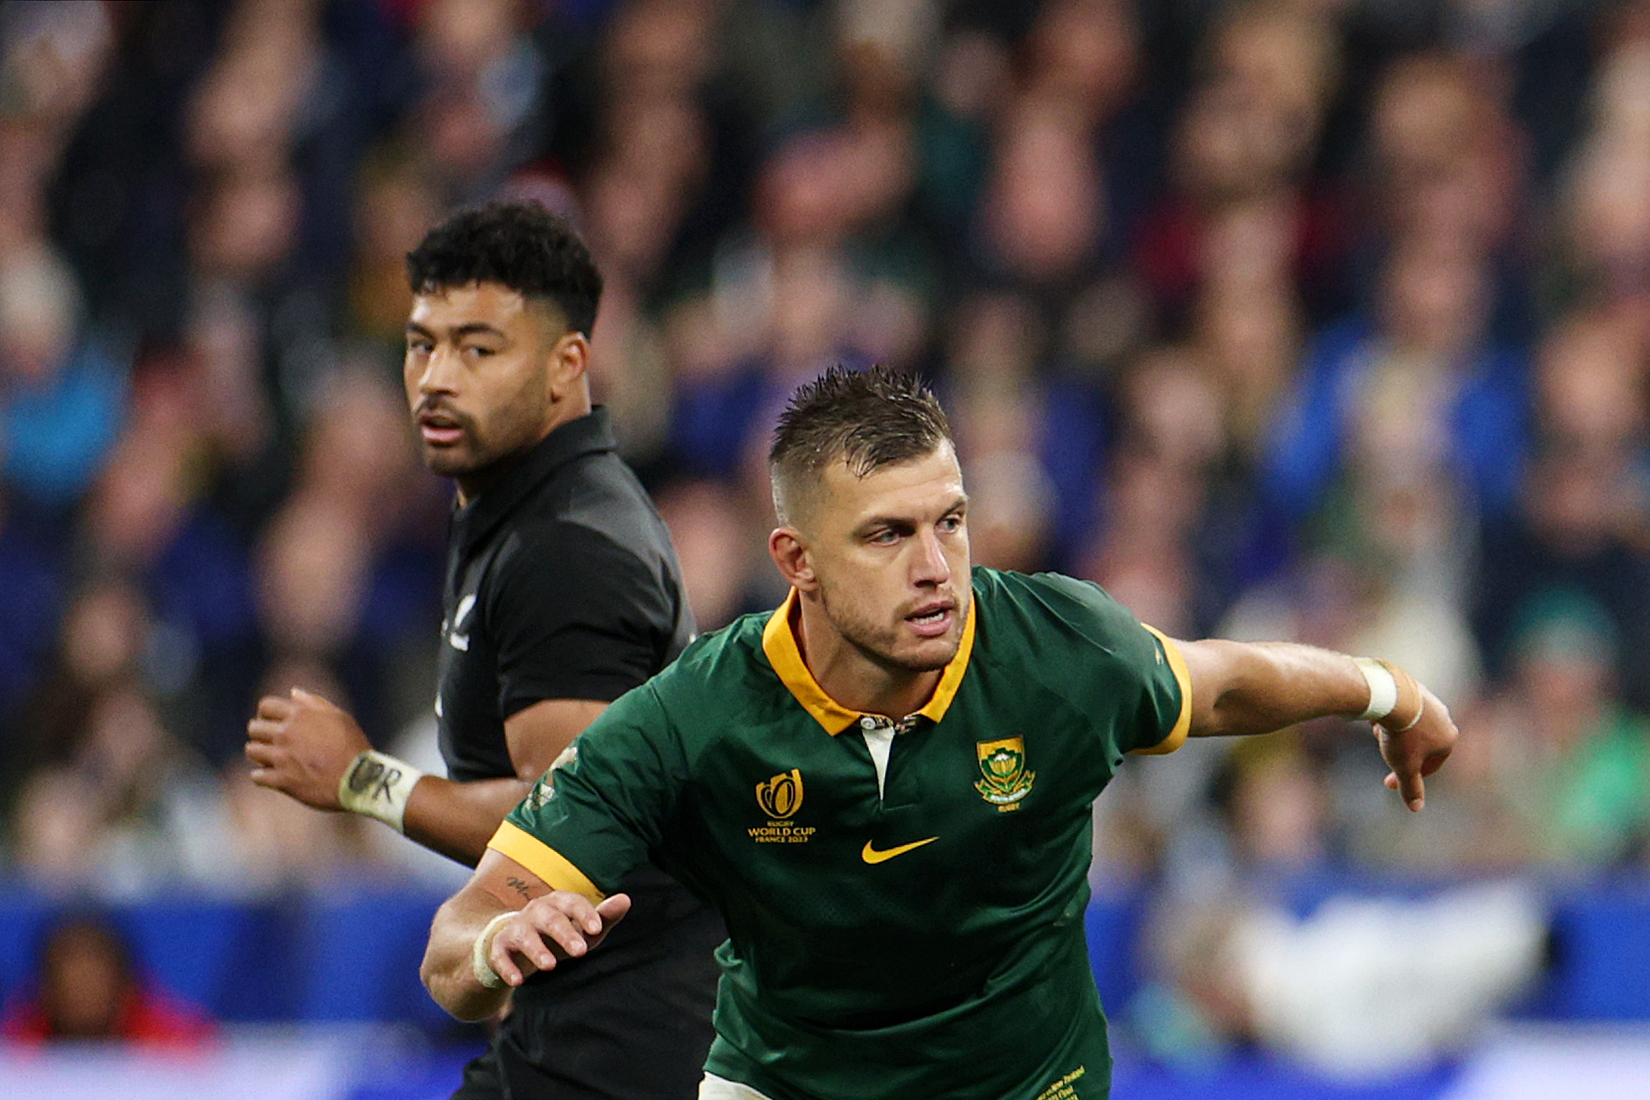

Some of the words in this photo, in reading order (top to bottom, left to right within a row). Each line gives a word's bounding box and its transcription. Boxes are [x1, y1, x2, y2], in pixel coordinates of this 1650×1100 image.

[747, 827, 792, 837] WORLD
[792, 826, 817, 836] CUP
[755, 835, 786, 843] FRANCE
[788, 835, 809, 843] 2023
